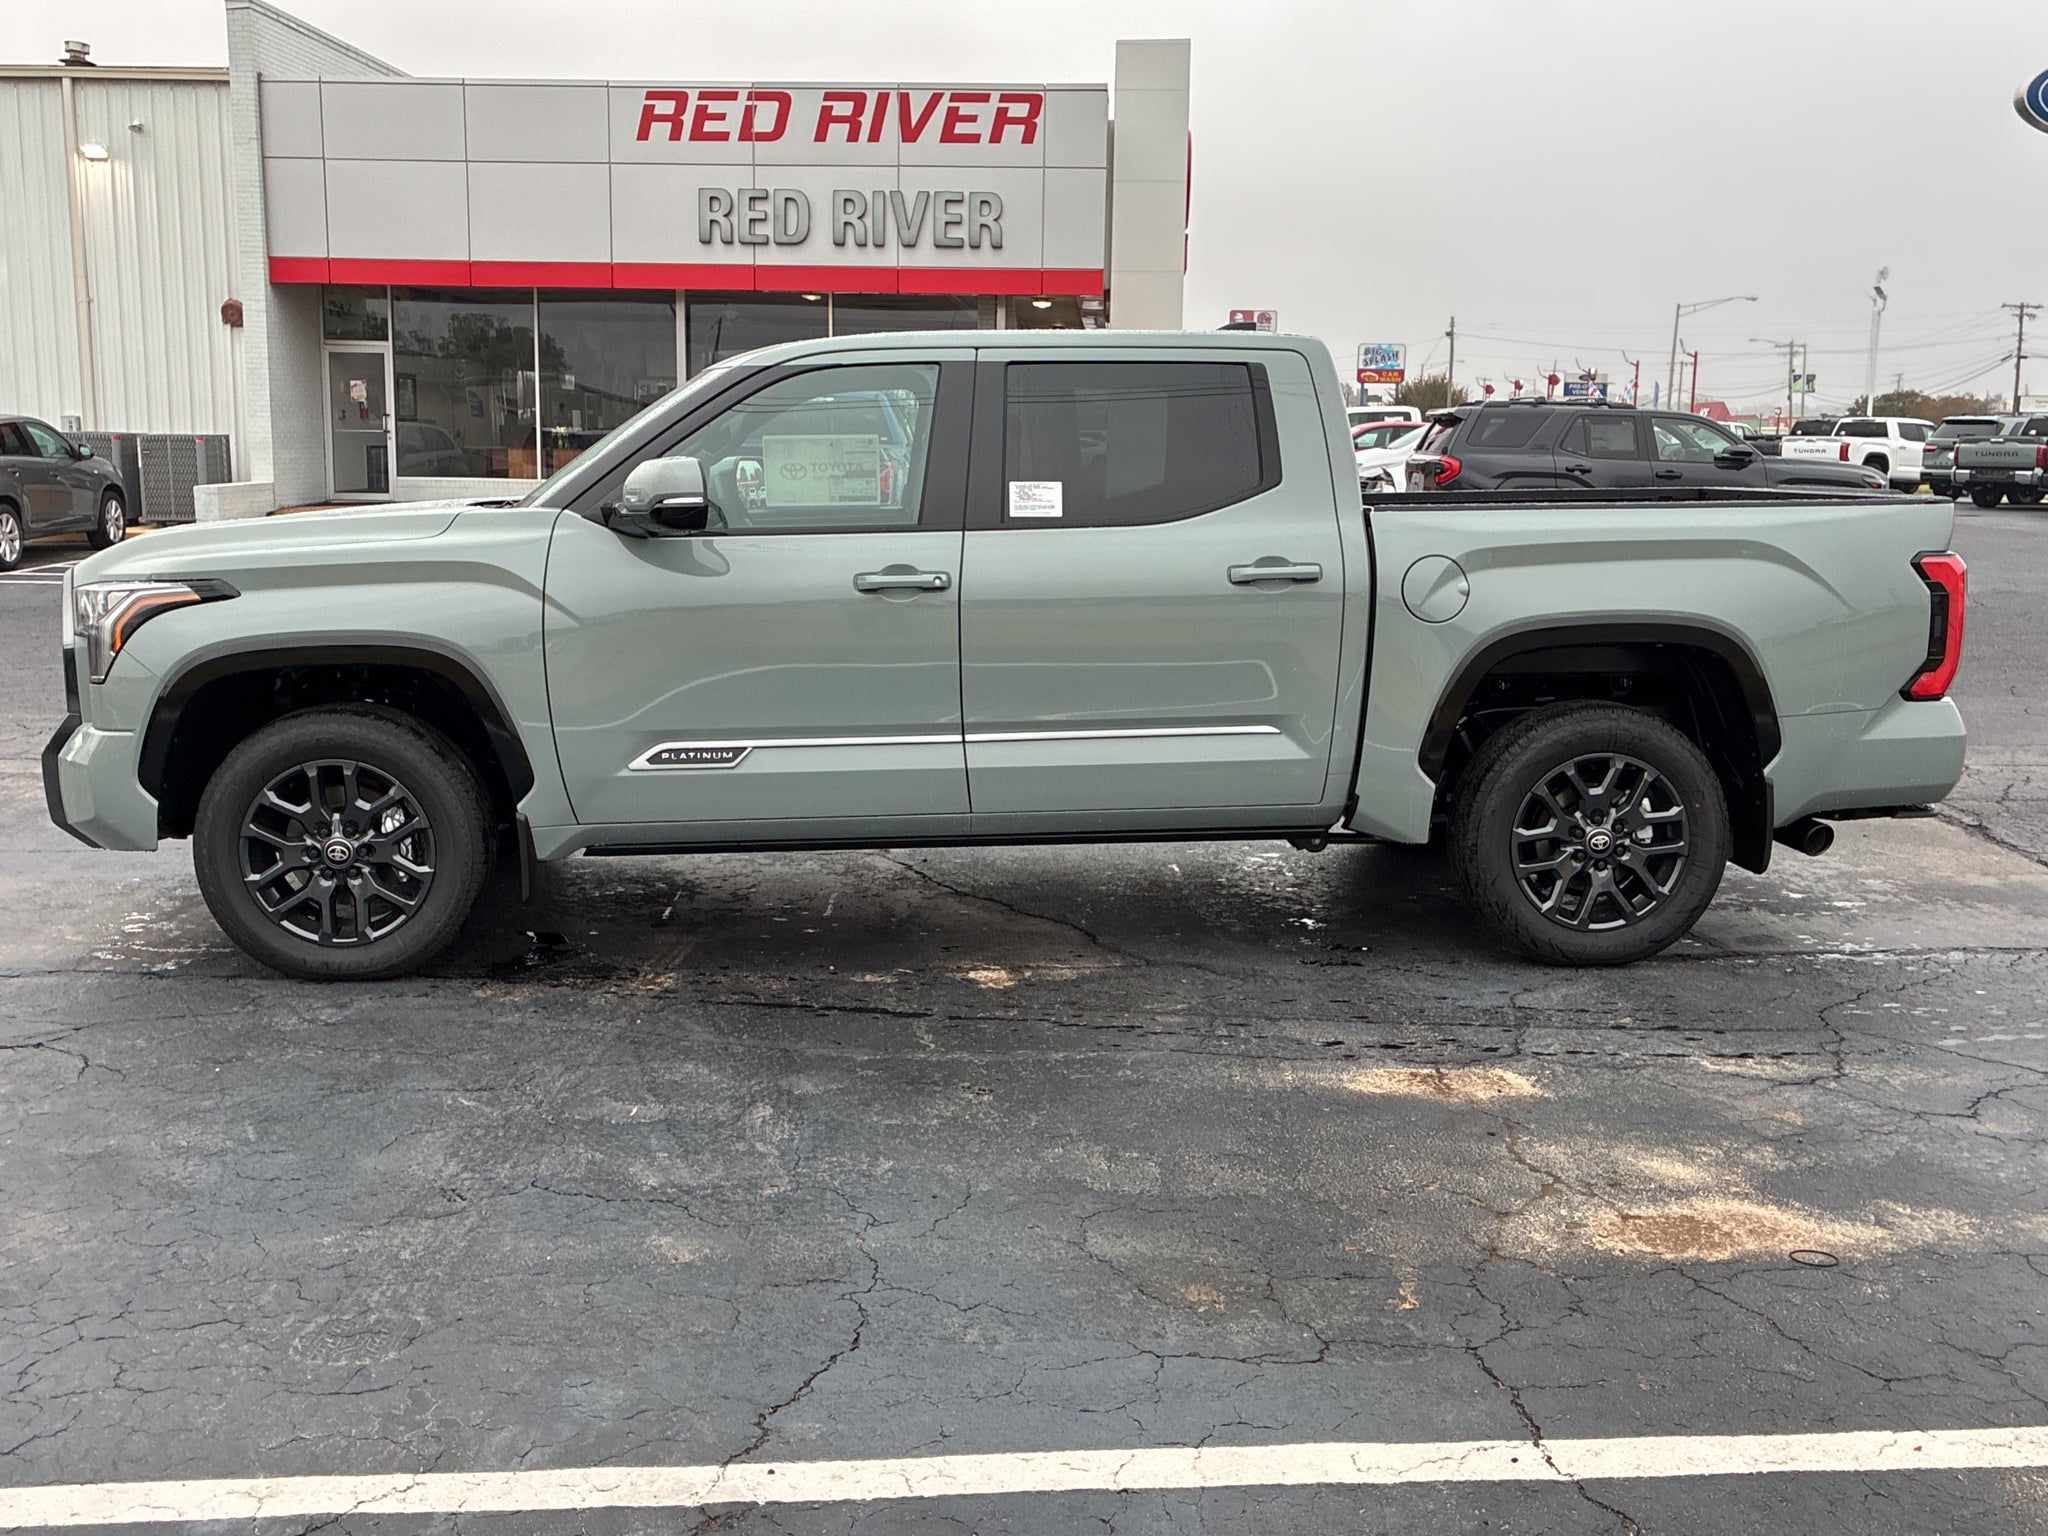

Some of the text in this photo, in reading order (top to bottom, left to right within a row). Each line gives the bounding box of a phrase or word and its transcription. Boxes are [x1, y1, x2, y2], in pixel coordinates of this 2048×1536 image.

[636, 90, 1044, 144] RED RIVER
[698, 187, 1004, 249] RED RIVER
[1363, 350, 1400, 366] SPLASH
[1364, 347, 1382, 356] BIG
[810, 462, 863, 473] TOYOTA
[661, 751, 733, 760] PLATINUM
